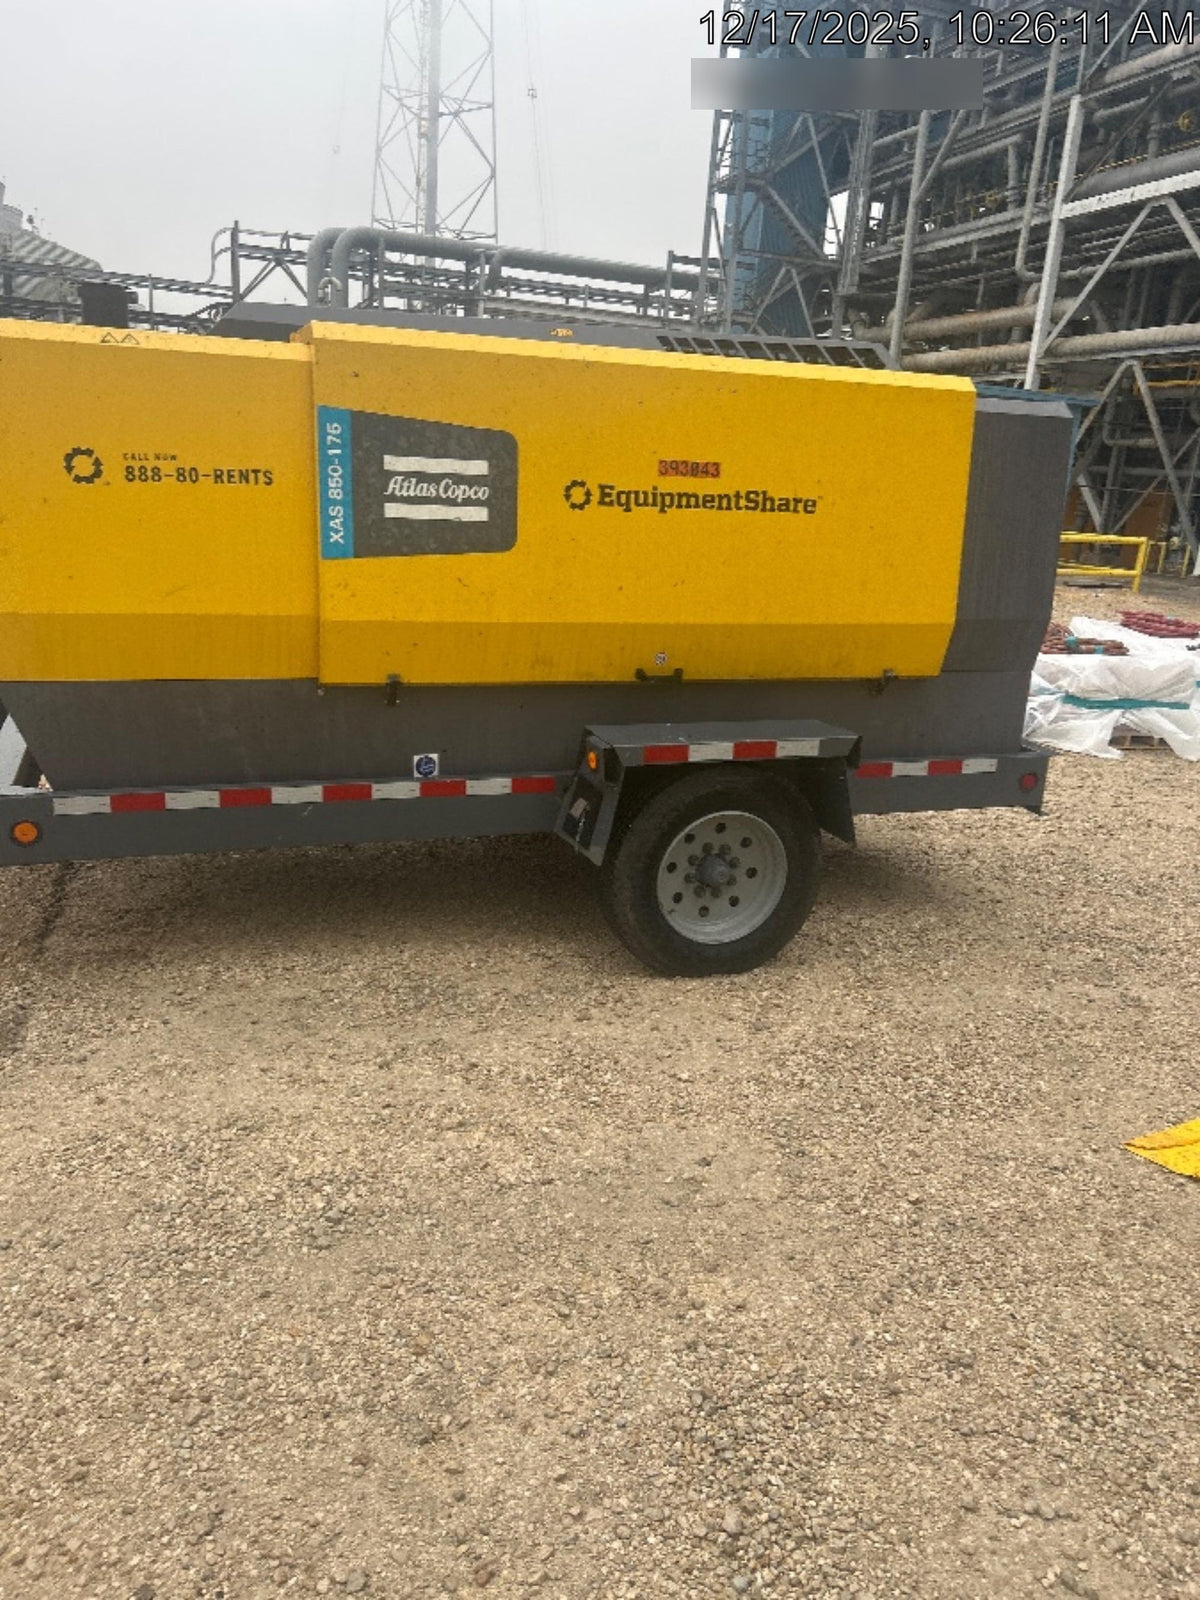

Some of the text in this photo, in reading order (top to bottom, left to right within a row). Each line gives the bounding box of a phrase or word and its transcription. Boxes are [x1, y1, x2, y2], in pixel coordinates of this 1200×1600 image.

[123, 453, 150, 461] CALL
[124, 465, 274, 486] 888-80-RENTS
[326, 422, 344, 544] XAS 850-175
[597, 484, 817, 514] EquipmentShare
